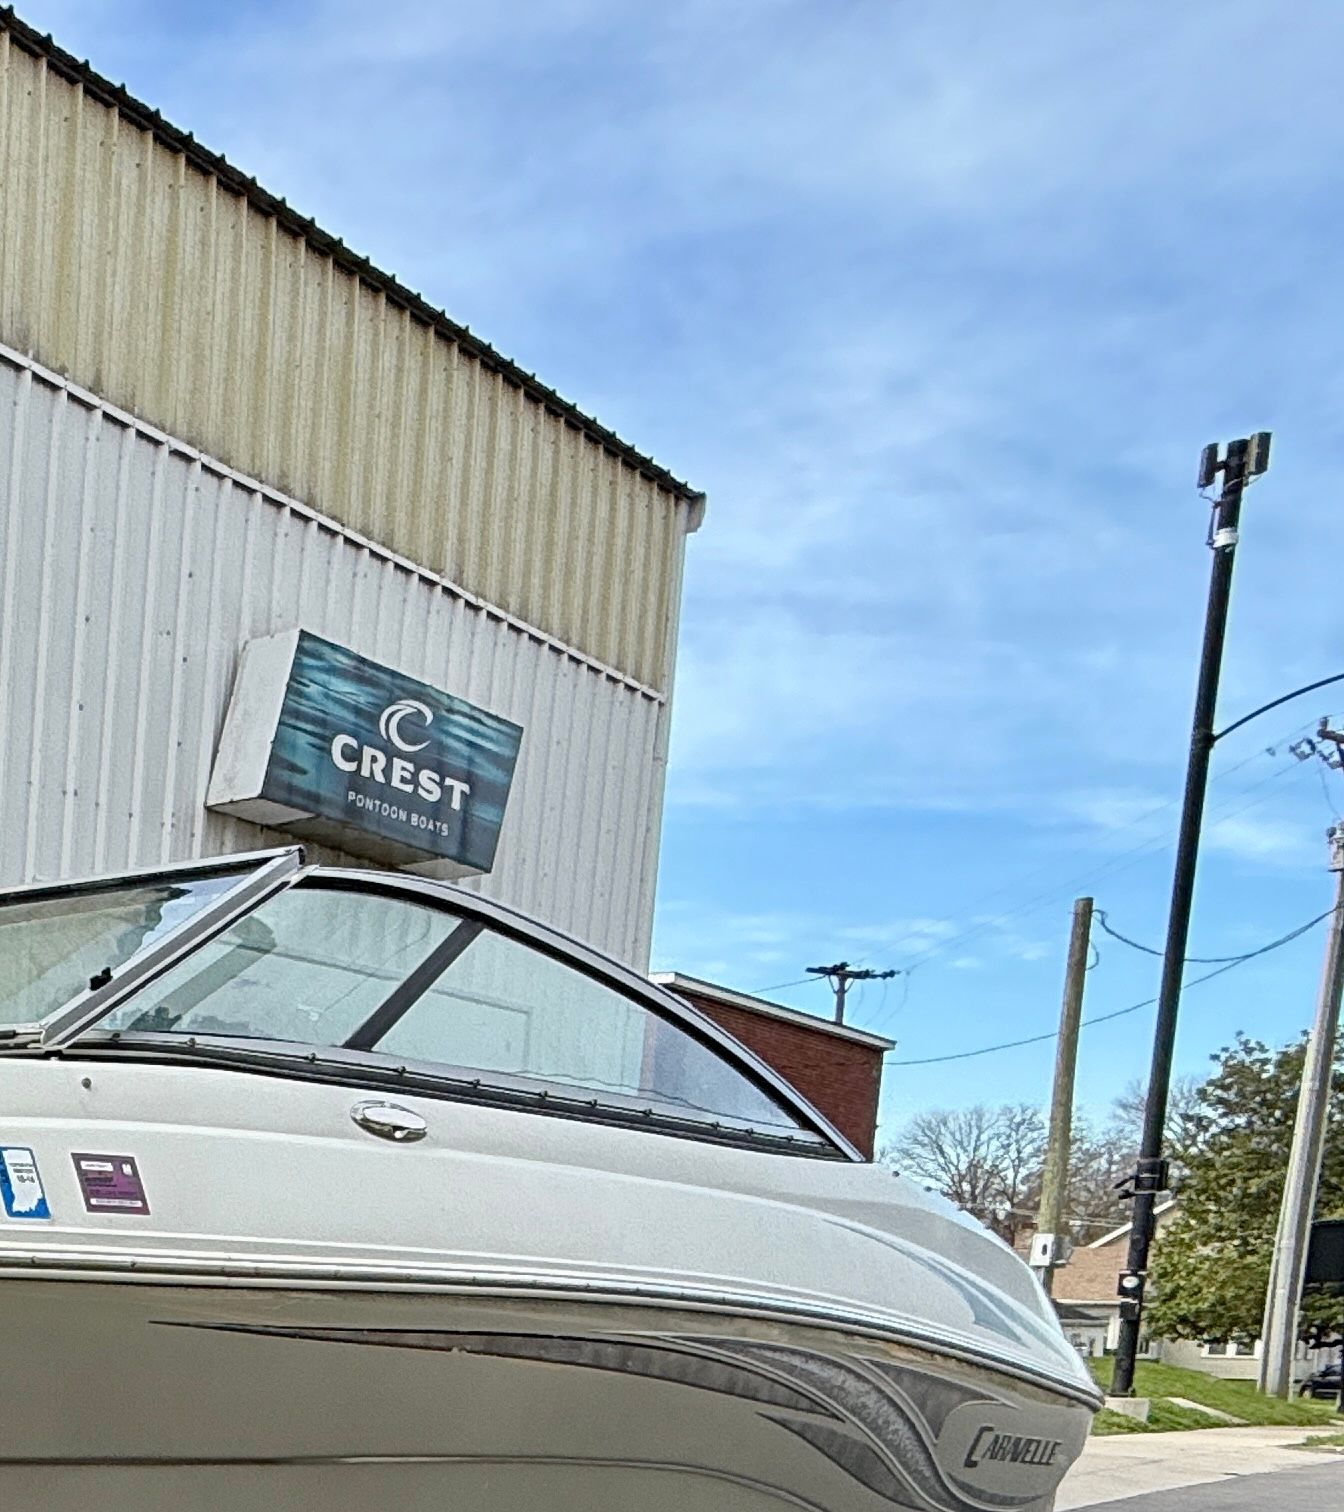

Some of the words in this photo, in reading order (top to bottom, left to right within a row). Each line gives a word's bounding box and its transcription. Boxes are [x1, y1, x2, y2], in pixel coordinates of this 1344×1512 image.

[330, 734, 471, 811] CREST
[347, 791, 408, 823] PONTOON
[410, 813, 449, 838] BOATS
[964, 1425, 1063, 1468] CARAVELLE
